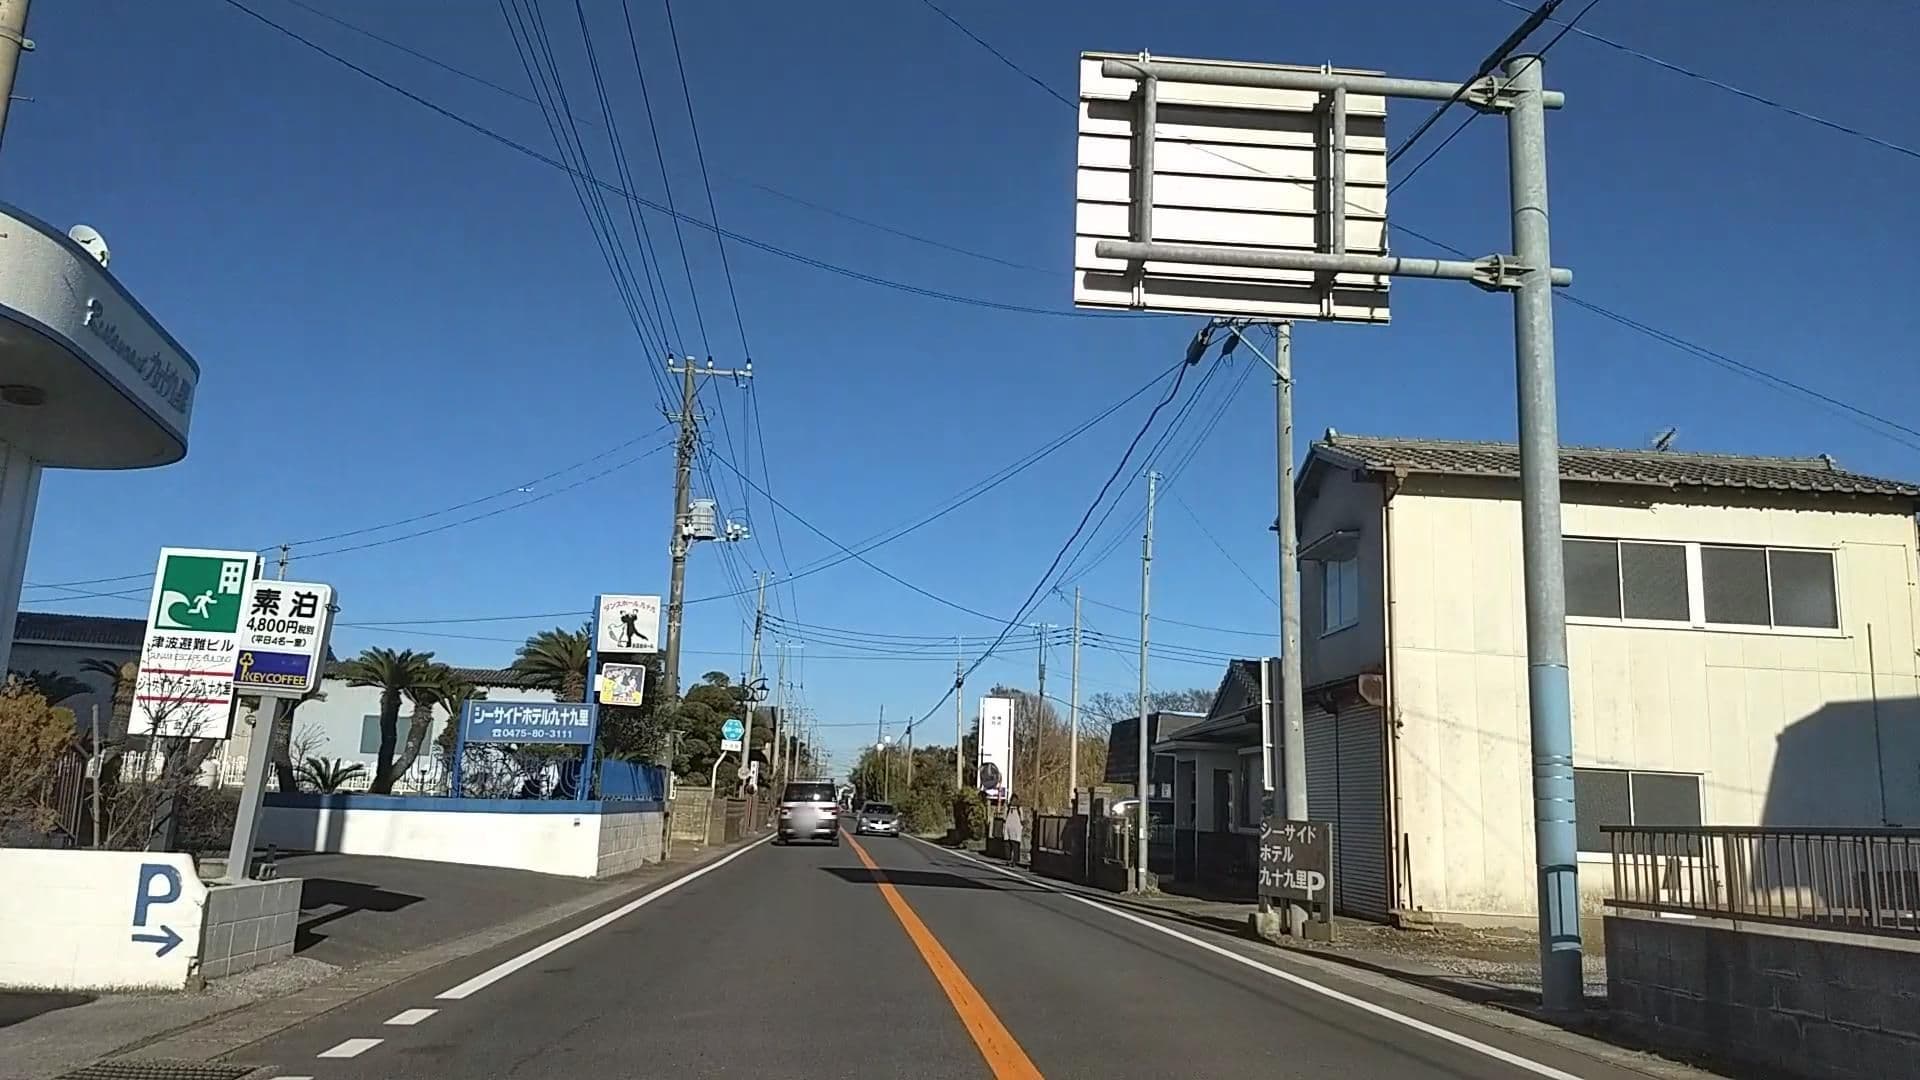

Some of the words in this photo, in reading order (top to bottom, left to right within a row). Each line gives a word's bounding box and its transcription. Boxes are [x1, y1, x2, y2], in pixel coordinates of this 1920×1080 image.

[151, 635, 235, 652] 津波避難ビル
[266, 673, 306, 685] COFFEE
[474, 706, 589, 726] シーサイドホテル九十九里
[502, 728, 573, 738] 0475-80-3111
[1260, 822, 1317, 844] シーサイド
[1260, 844, 1294, 863] ホテル
[133, 864, 182, 926] P
